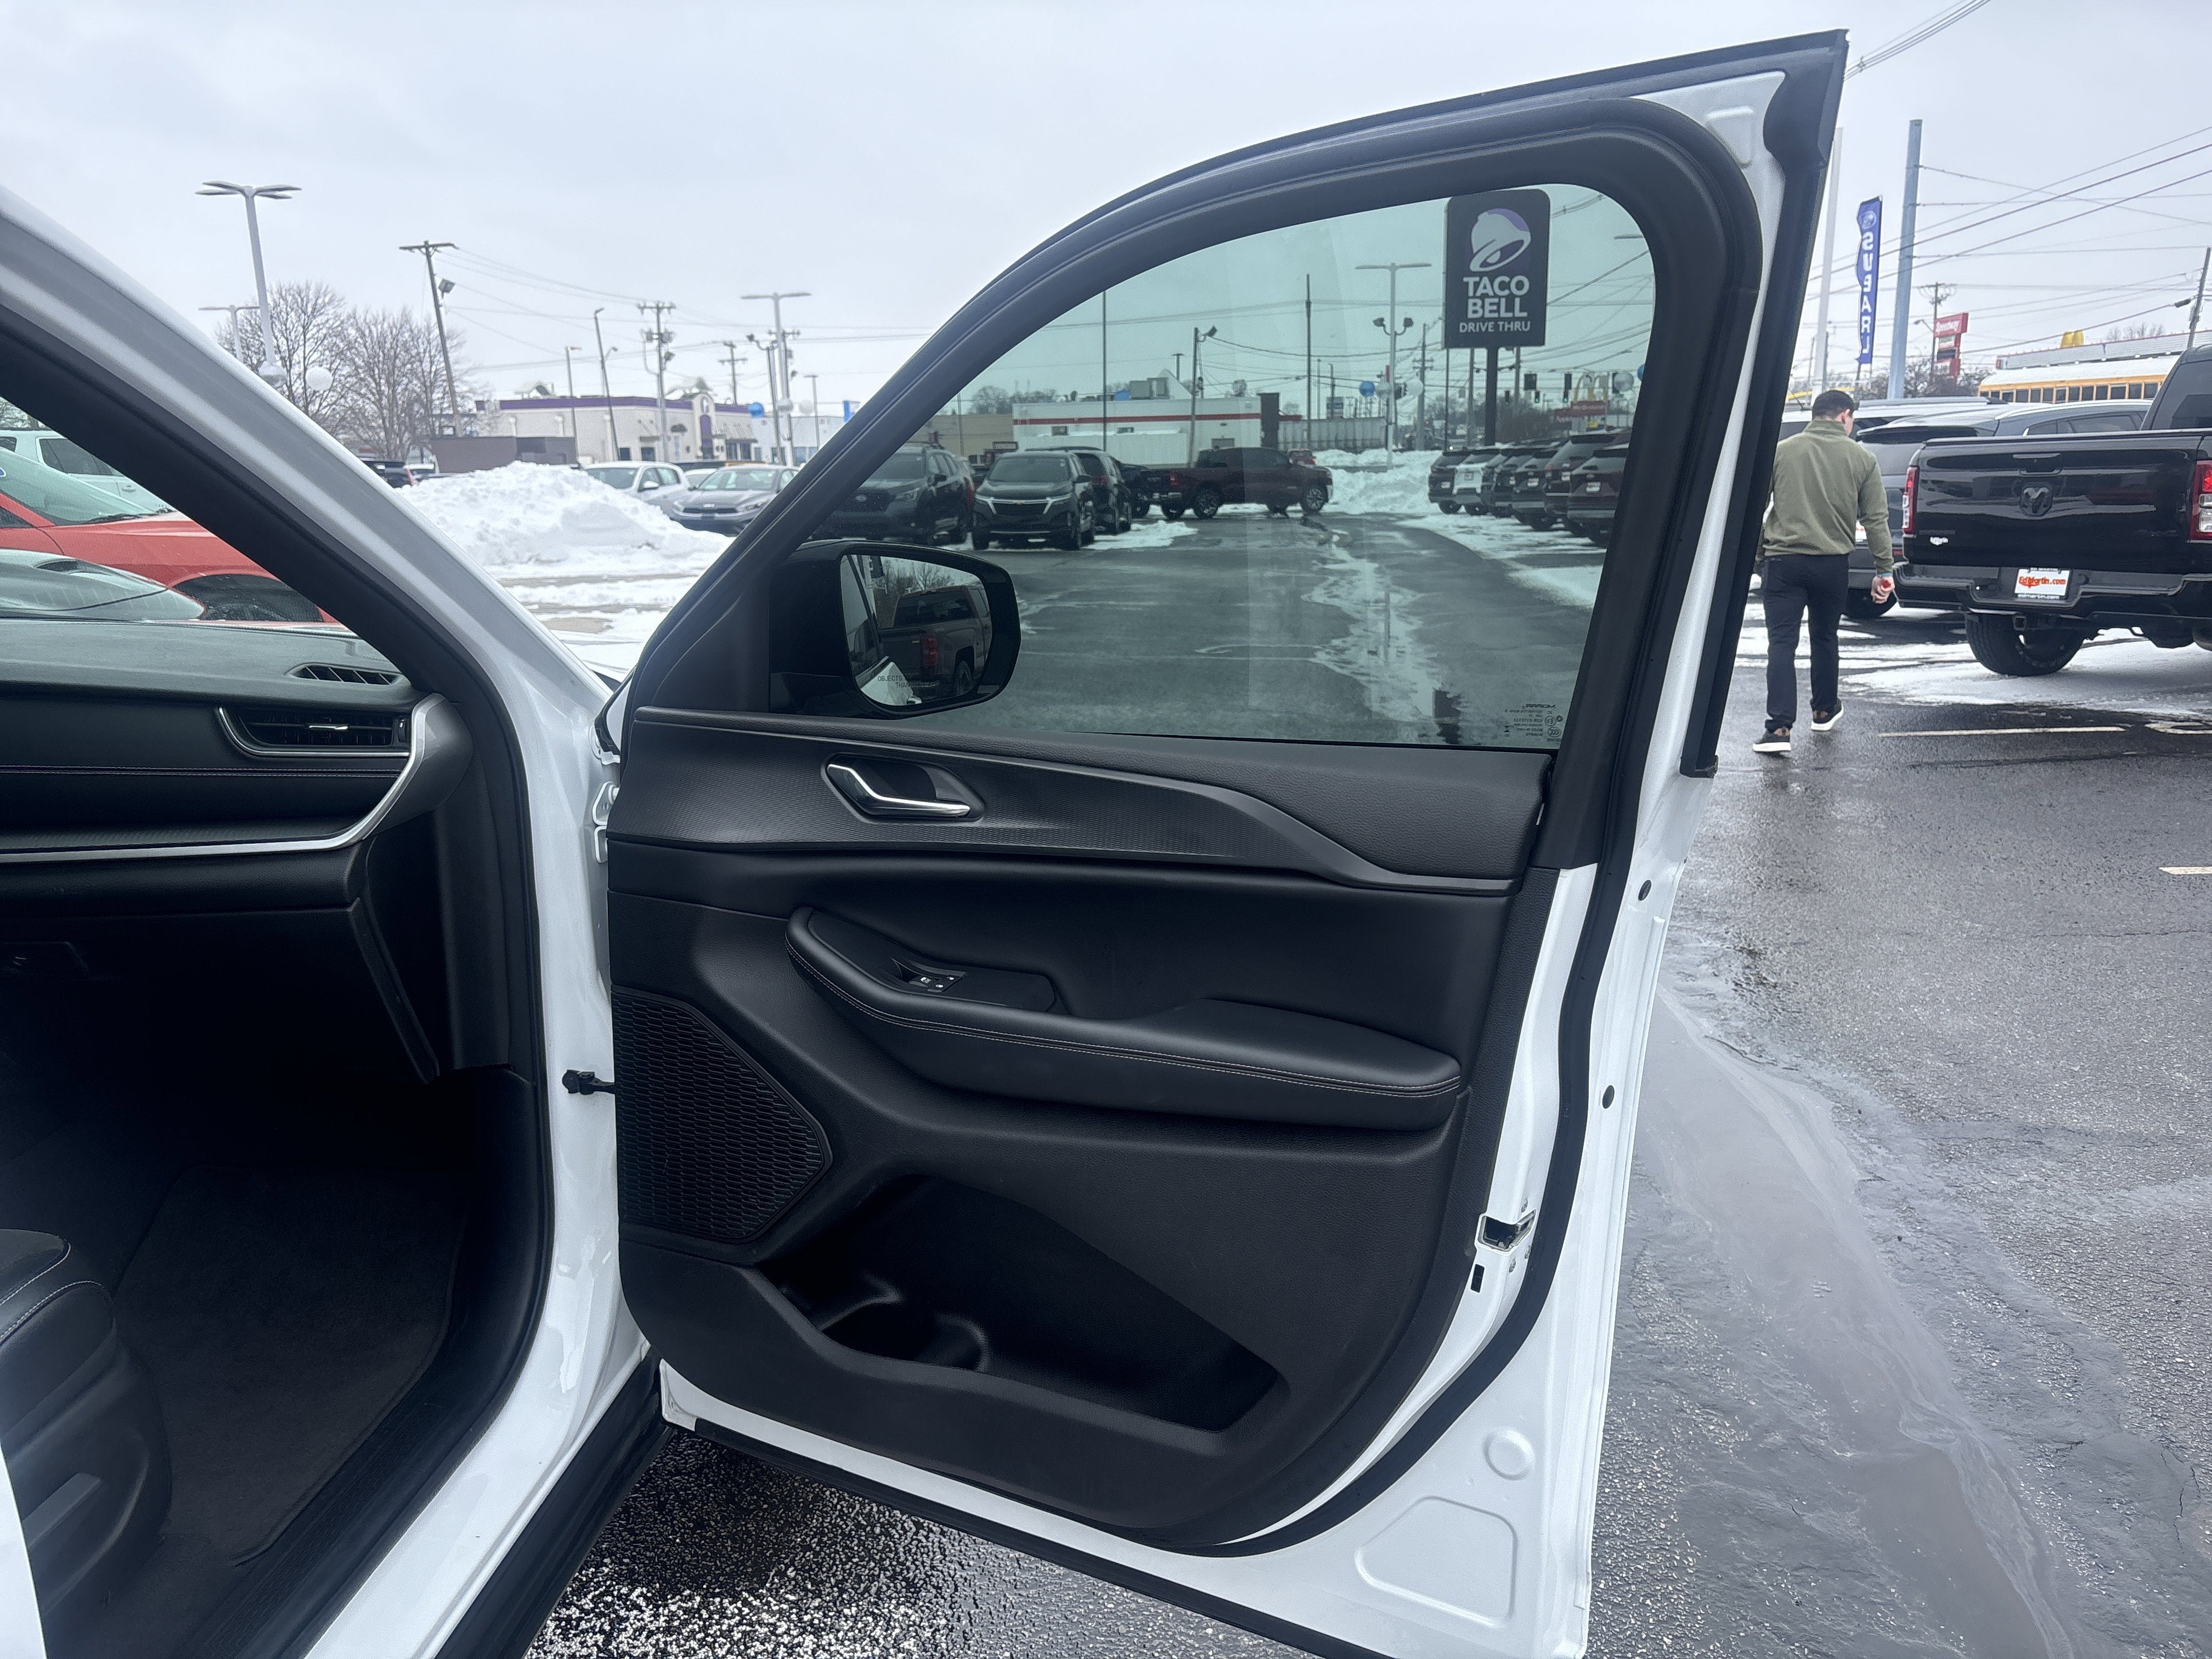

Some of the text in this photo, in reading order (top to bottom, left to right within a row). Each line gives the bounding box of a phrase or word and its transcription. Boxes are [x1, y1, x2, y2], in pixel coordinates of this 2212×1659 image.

[1463, 275, 1530, 296] TACO
[1467, 297, 1528, 318] BELL
[1459, 320, 1531, 333] DRIVE THRU
